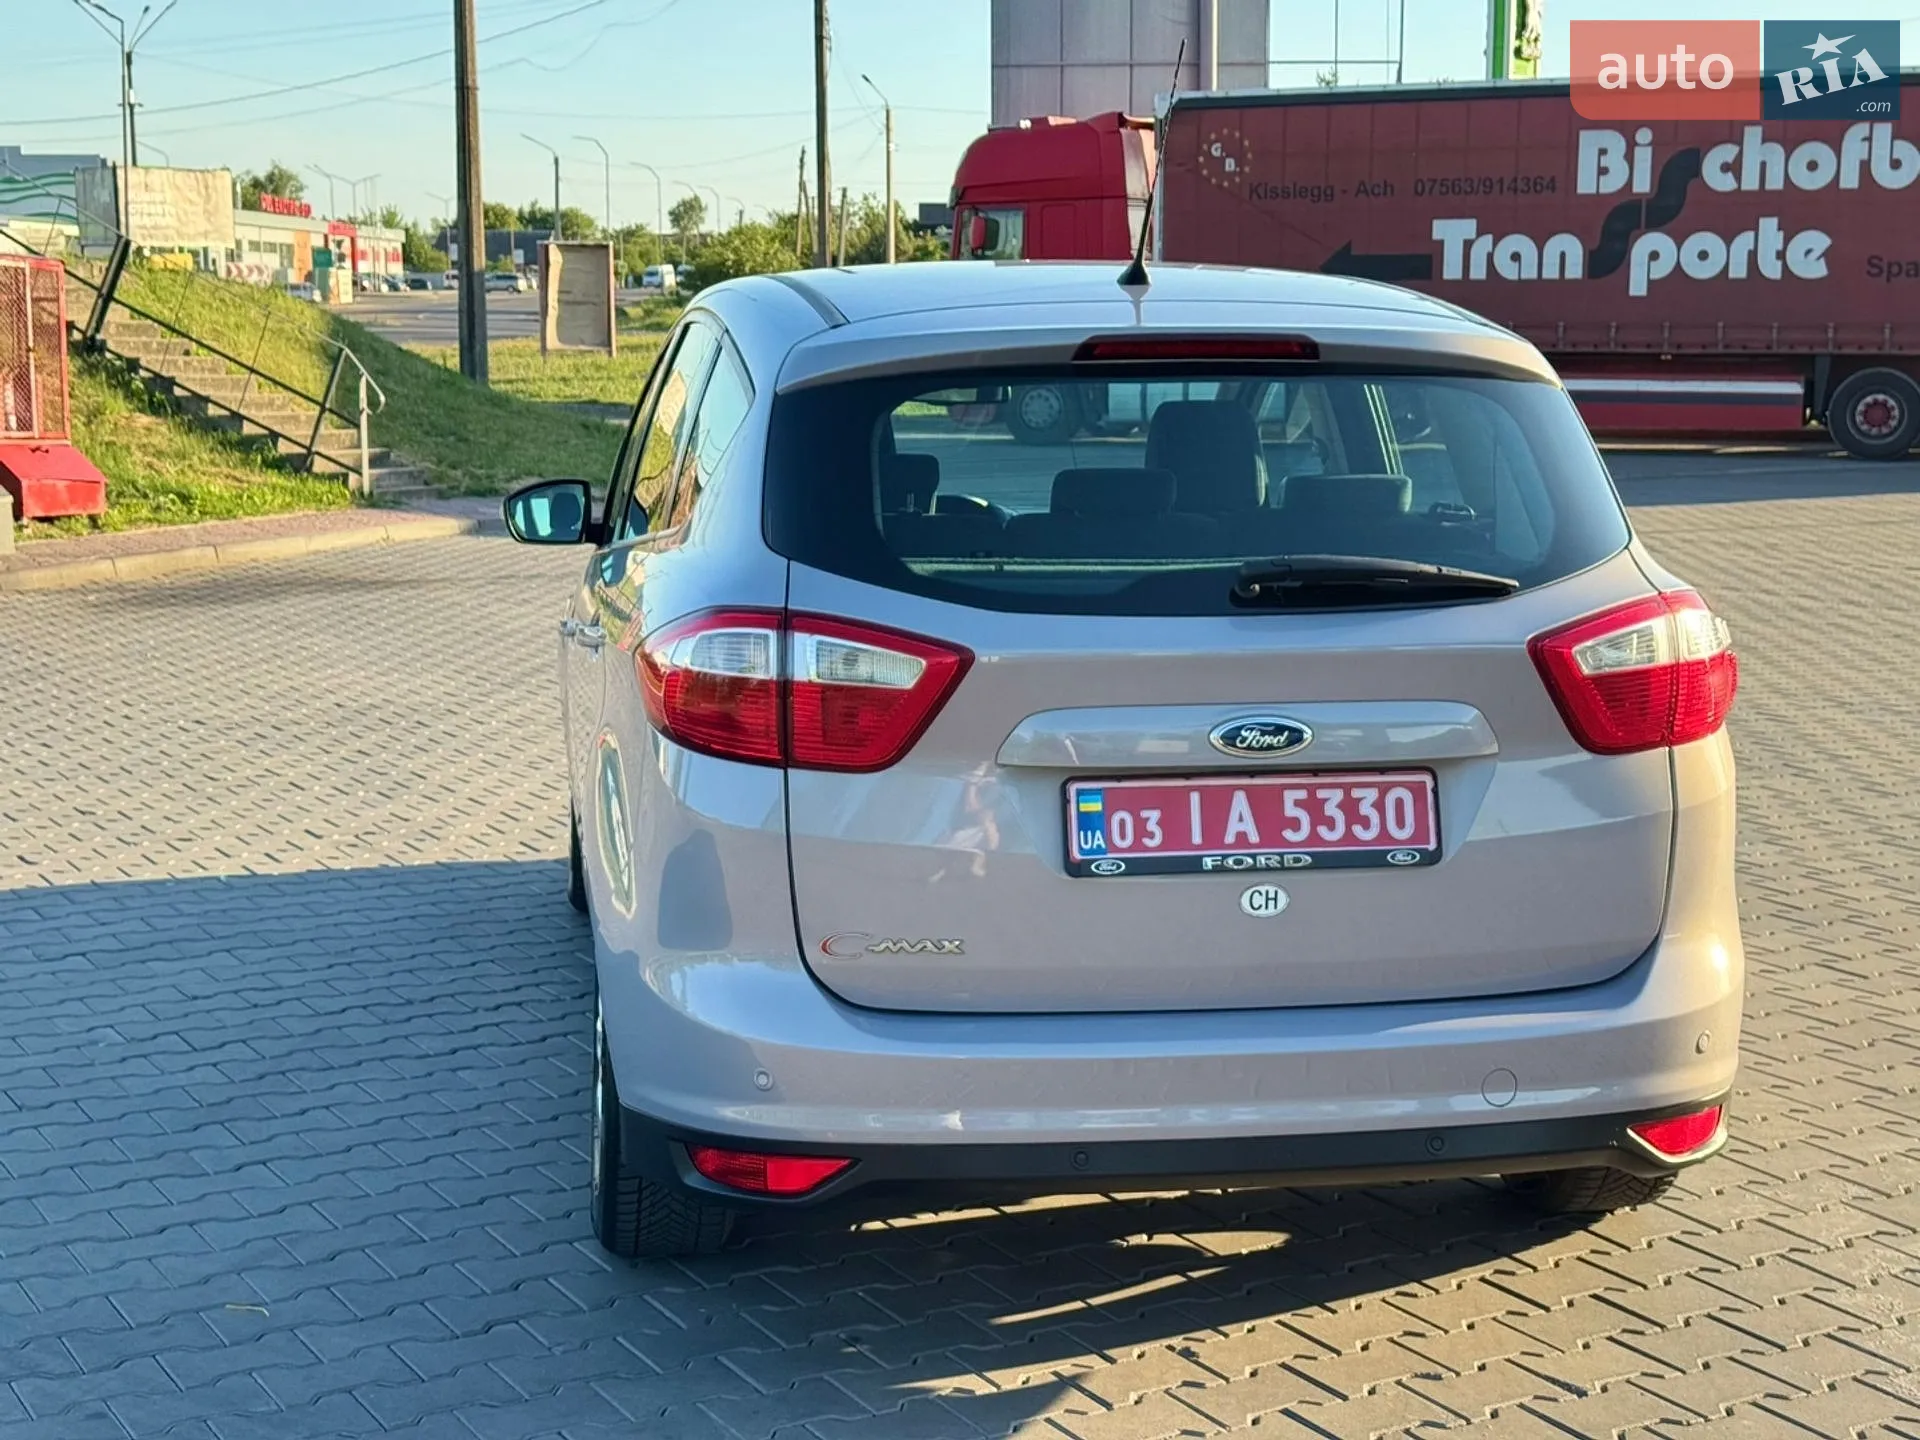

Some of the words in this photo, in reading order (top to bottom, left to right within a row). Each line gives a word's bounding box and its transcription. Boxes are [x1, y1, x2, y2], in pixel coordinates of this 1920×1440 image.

[1249, 181, 1335, 203] Kisslegg
[1354, 179, 1395, 198] Ach
[1414, 175, 1558, 197] 07563/914364
[1236, 724, 1290, 749] Ford
[1079, 830, 1106, 850] UA
[1110, 809, 1164, 849] 03
[1281, 786, 1416, 843] 5330
[1202, 854, 1313, 871] FORD
[1249, 889, 1279, 911] CH
